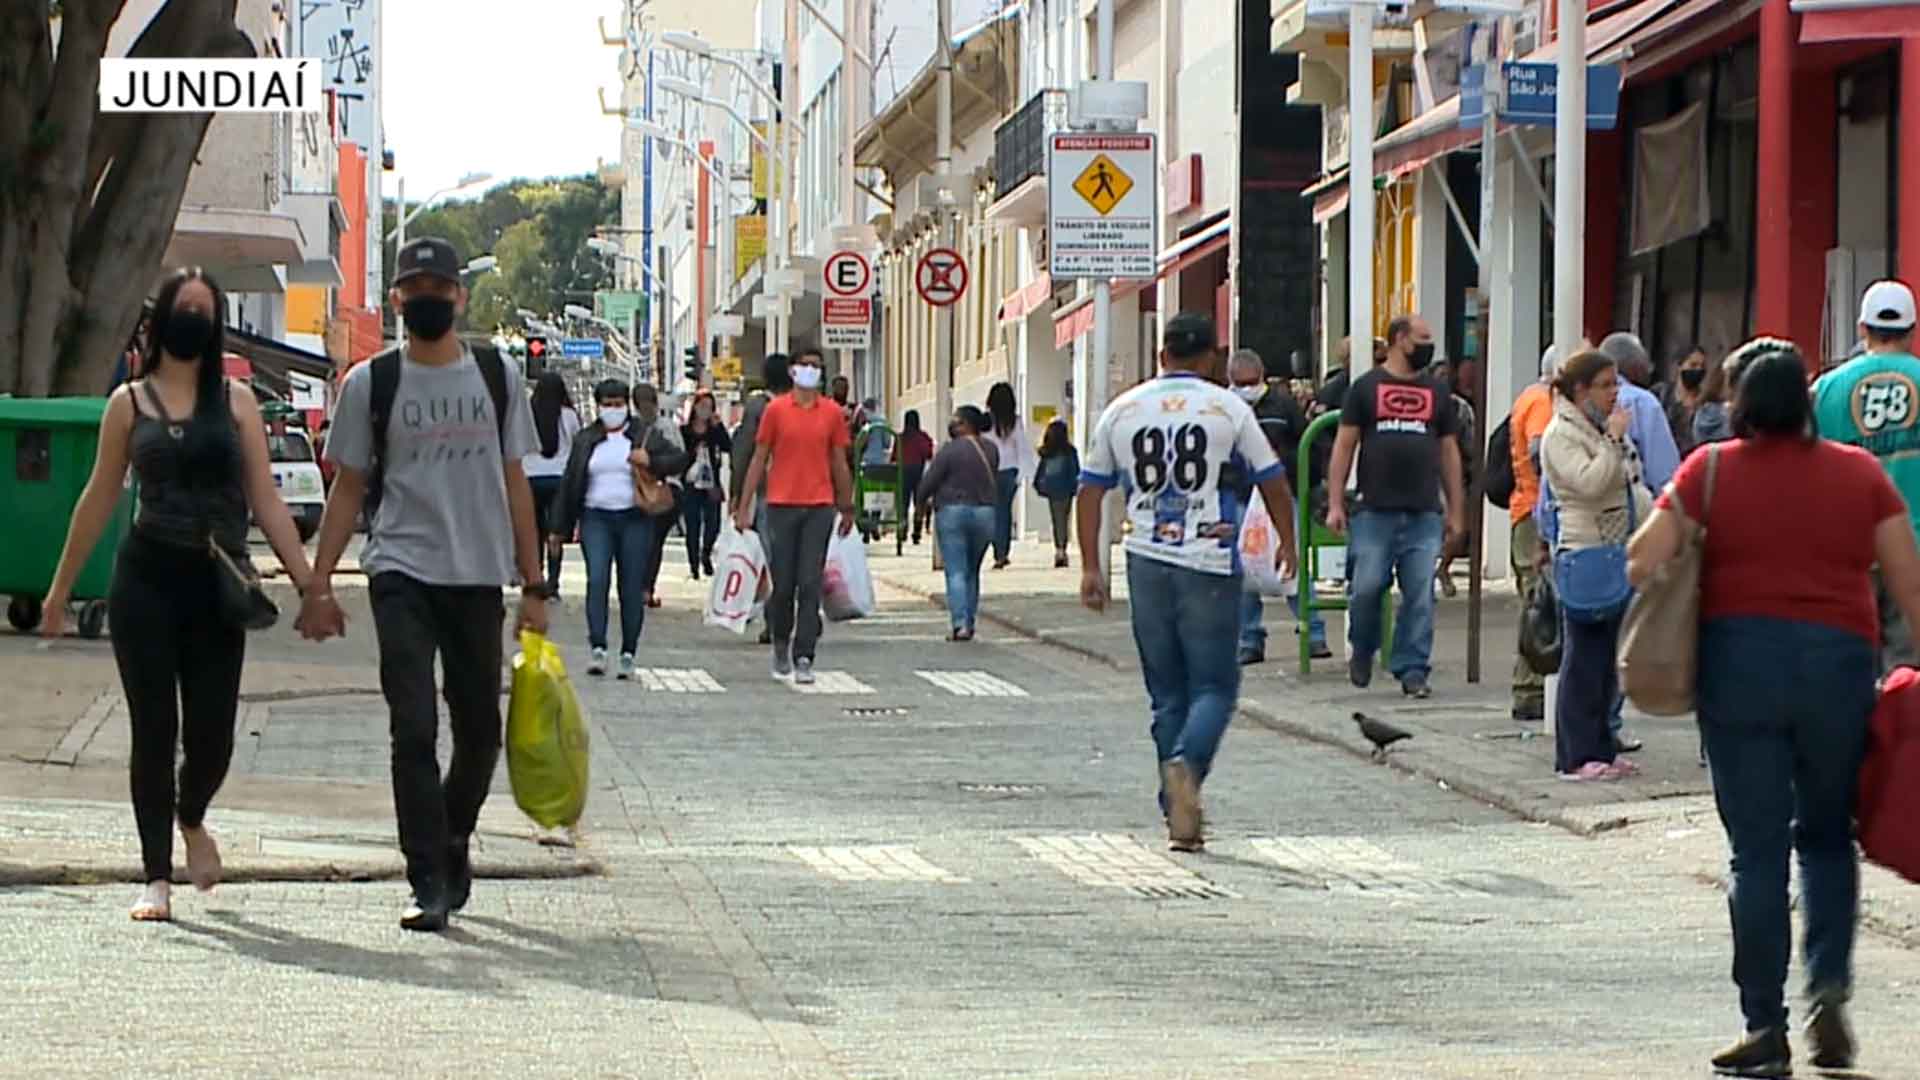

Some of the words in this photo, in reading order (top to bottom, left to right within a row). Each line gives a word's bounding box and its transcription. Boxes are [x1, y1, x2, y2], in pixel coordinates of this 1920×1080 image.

[1509, 67, 1536, 80] Rua
[1510, 82, 1536, 95] São
[1539, 83, 1557, 95] Jo
[838, 261, 858, 287] E
[402, 396, 488, 429] QUIK
[1132, 421, 1208, 494] 88
